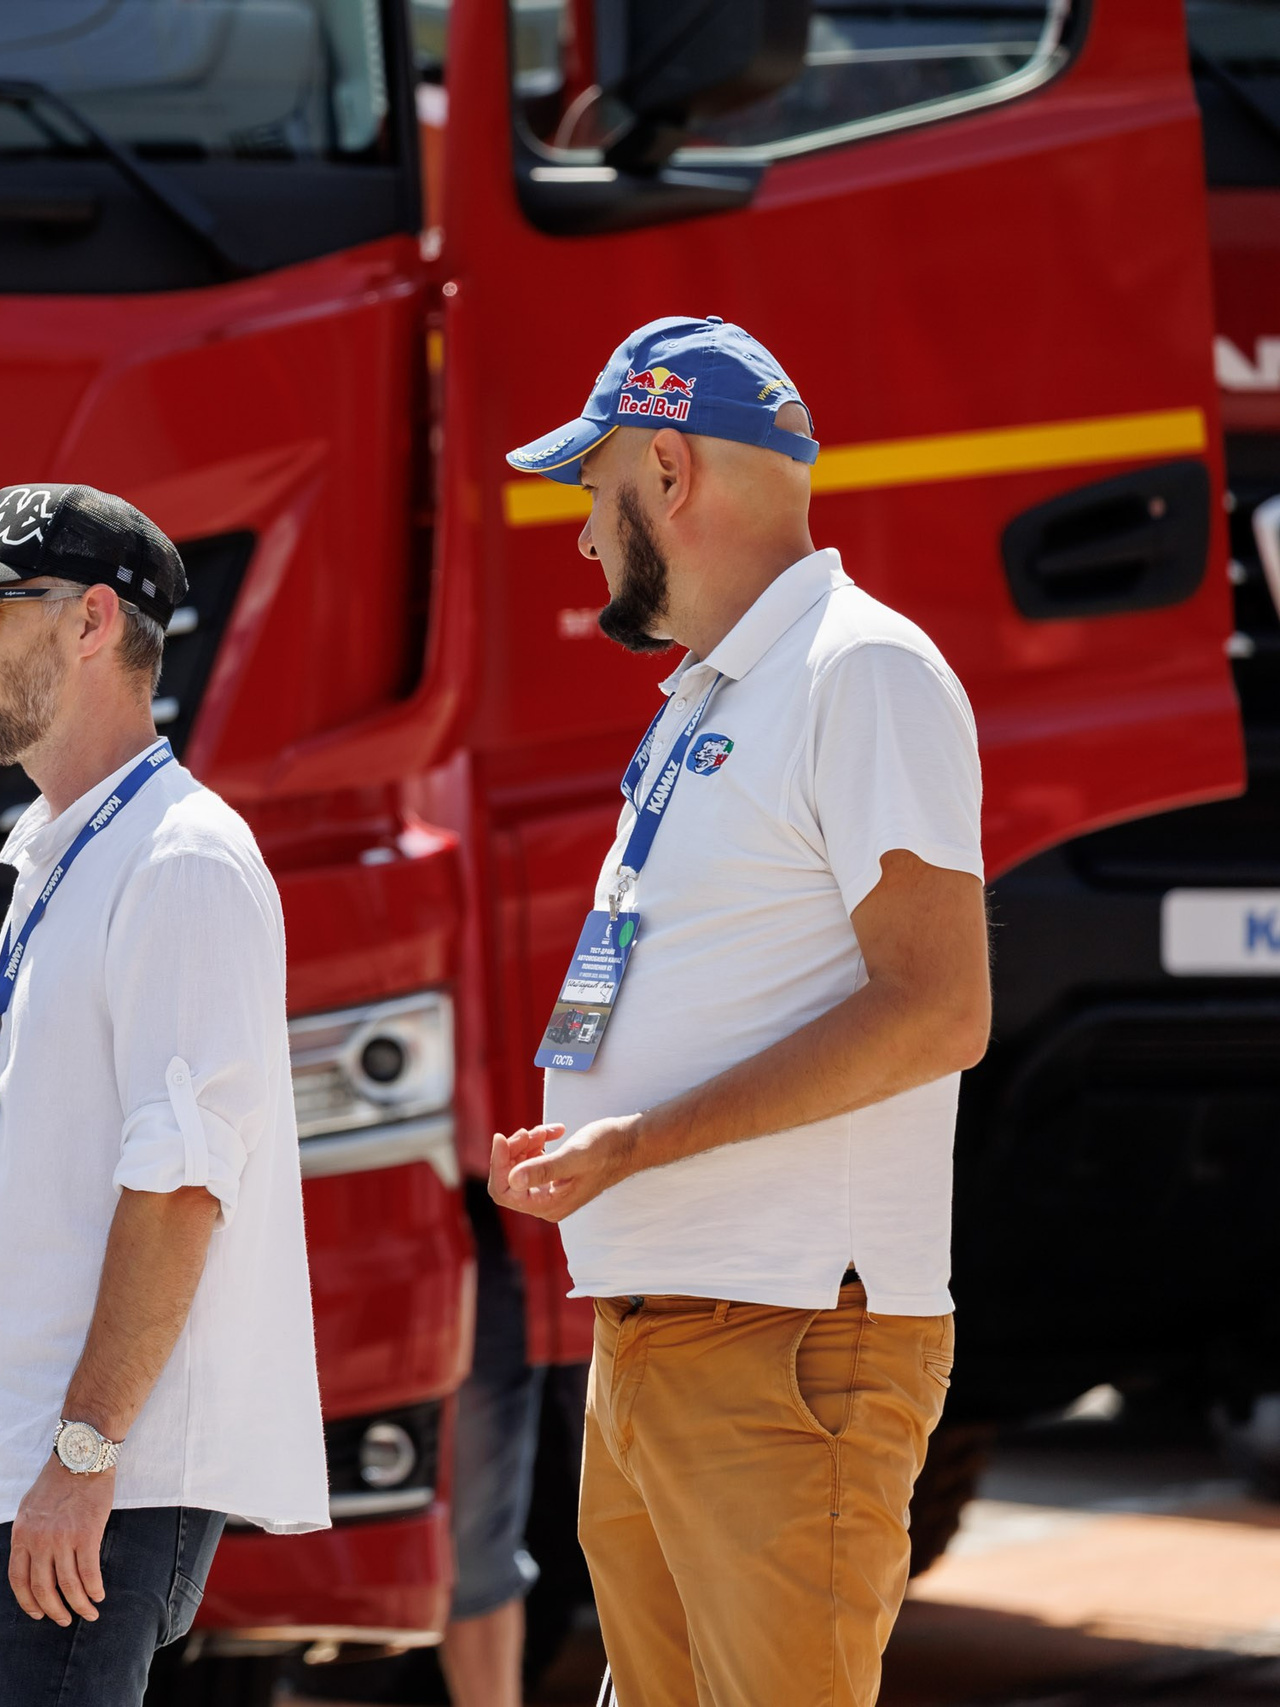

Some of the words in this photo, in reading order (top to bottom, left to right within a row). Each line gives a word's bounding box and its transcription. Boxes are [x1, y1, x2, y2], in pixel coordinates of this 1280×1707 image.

[618, 393, 654, 415] Red
[651, 396, 691, 421] Bull
[646, 760, 680, 815] KAMAZ
[89, 794, 122, 831] KAMAZ
[40, 865, 64, 903] KAMAZ
[4, 942, 24, 981] KAMAZ
[552, 1054, 573, 1066] ГОСТЬ
